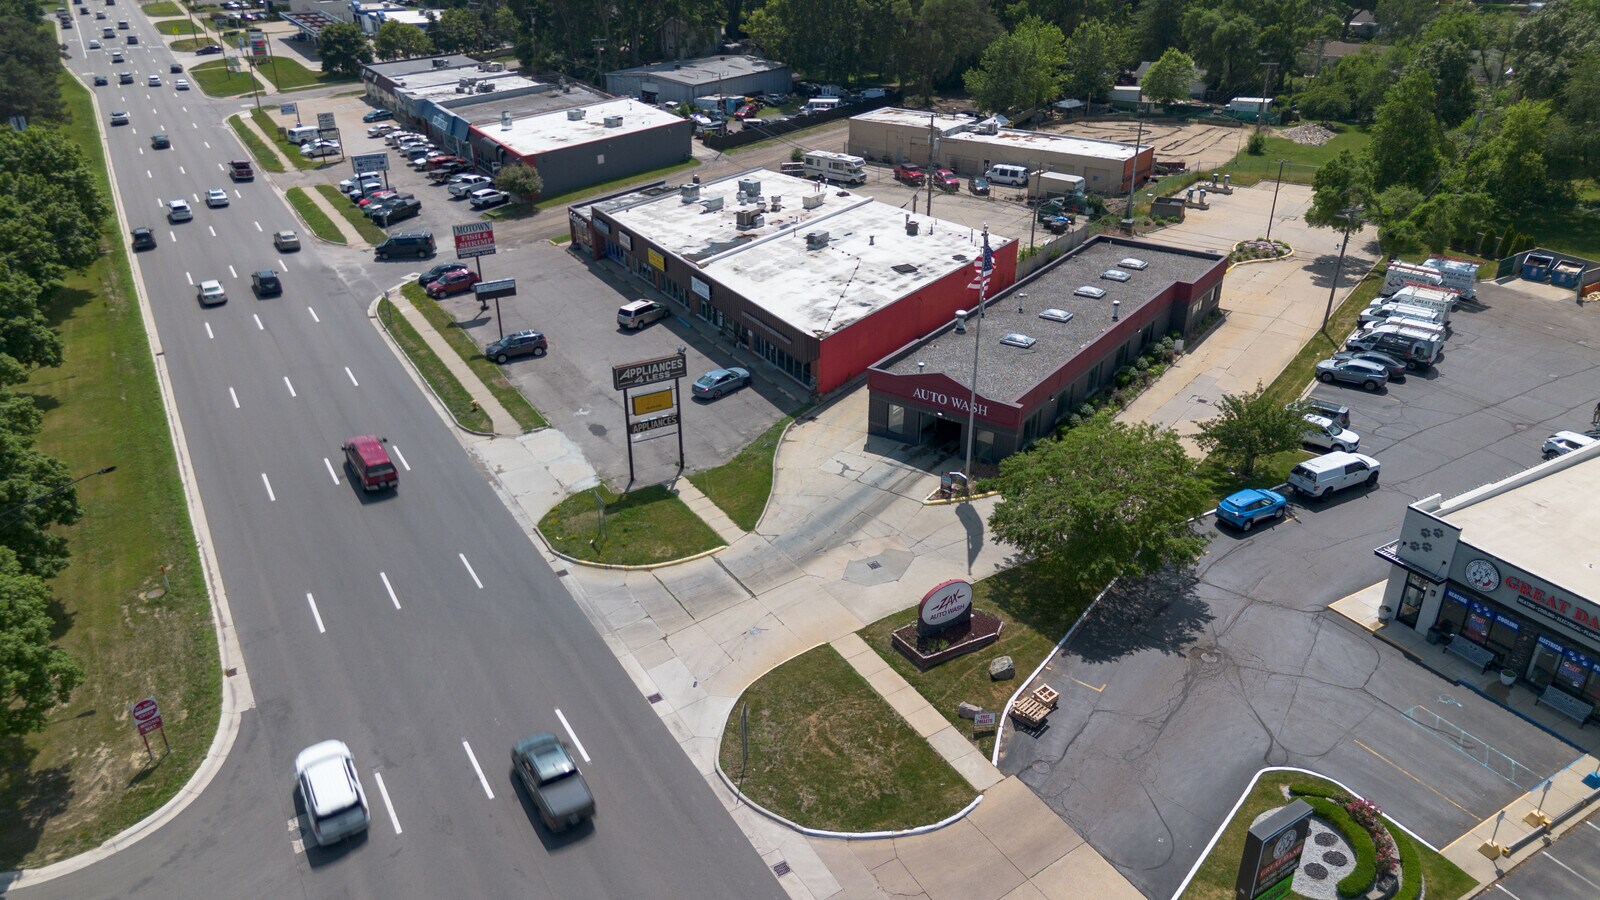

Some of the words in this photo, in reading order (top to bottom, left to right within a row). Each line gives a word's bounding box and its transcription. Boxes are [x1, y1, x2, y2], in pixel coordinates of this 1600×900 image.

[456, 222, 491, 234] MOTOWN
[459, 238, 493, 249] SHRIMP
[461, 233, 481, 241] FISH
[1414, 298, 1430, 306] GREAT
[619, 359, 683, 380] APPLIANCES
[634, 375, 644, 384] 4
[646, 371, 671, 382] LESS
[913, 387, 948, 405] AUTO
[633, 416, 677, 433] APPLIANCES
[935, 588, 962, 611] ZAX
[1447, 590, 1468, 604] HEATING
[1505, 577, 1570, 613] GREAT
[930, 610, 947, 621] AUTO
[947, 603, 965, 614] WASH
[1518, 597, 1536, 609] HEATING
[1537, 606, 1555, 619] COOLING
[1497, 615, 1519, 630] COOLING
[1538, 636, 1563, 653] ELECTRICAL
